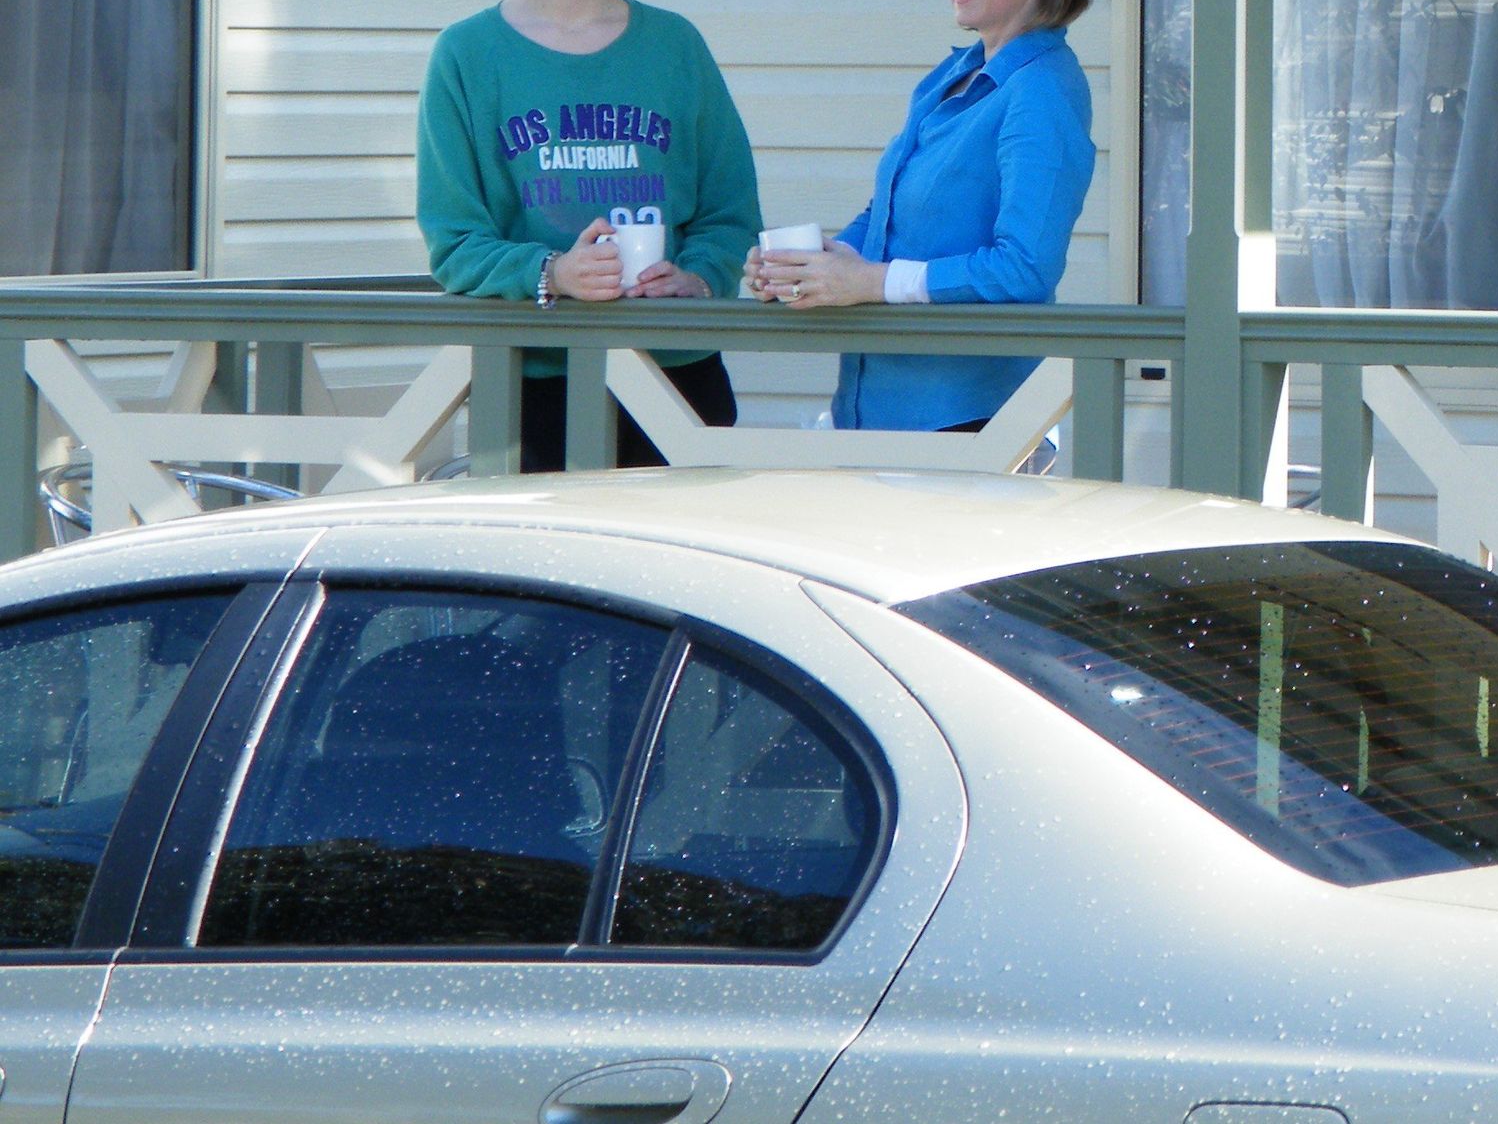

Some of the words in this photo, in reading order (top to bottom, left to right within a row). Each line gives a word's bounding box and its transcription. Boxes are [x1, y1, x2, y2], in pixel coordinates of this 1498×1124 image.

[498, 108, 550, 161] LOS
[559, 103, 672, 155] ANGELES
[538, 144, 639, 171] CALIFORNIA
[576, 173, 667, 205] DIVISION
